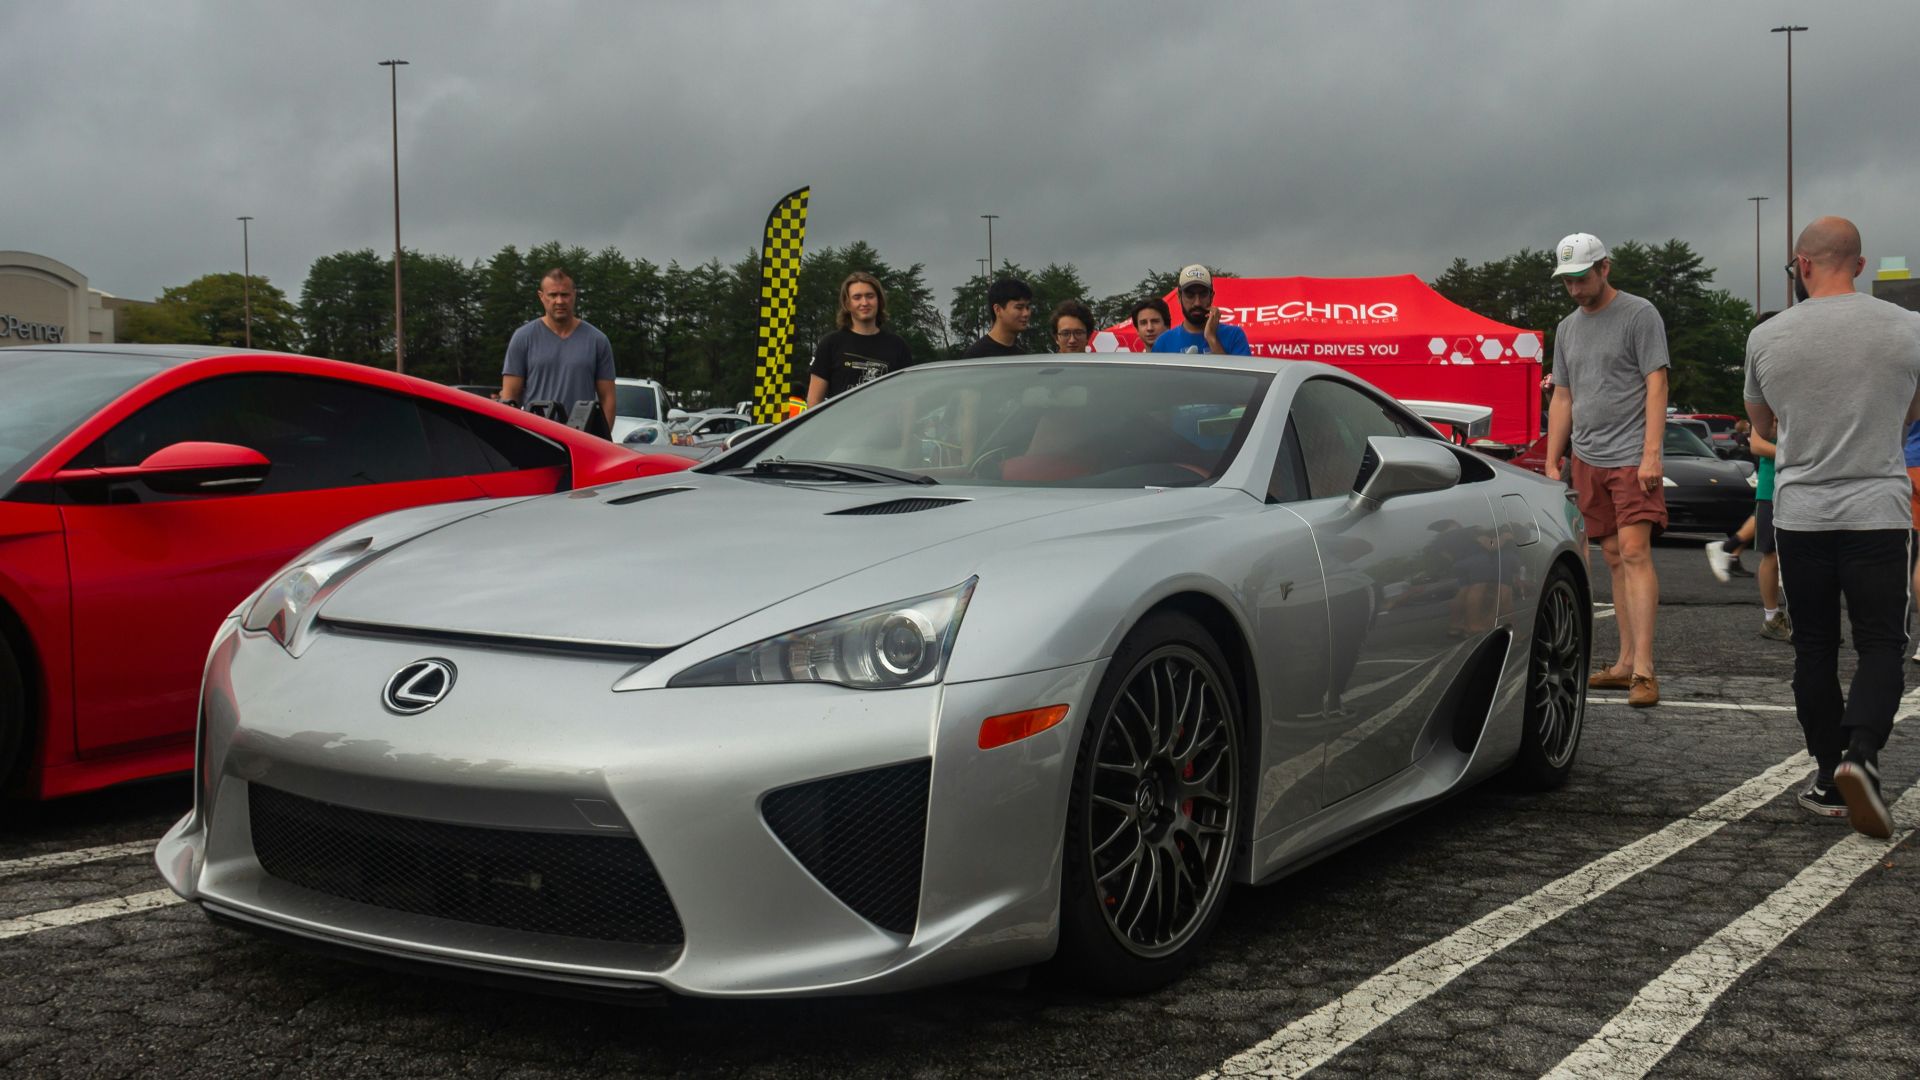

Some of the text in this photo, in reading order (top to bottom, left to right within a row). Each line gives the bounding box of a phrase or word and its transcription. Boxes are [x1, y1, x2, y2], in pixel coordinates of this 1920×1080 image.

[1263, 316, 1328, 327] SURFACE
[1336, 316, 1399, 325] SCIENCE
[1268, 344, 1310, 355] WHAT
[1314, 344, 1365, 355] DRIVES
[1369, 344, 1399, 355] YOU
